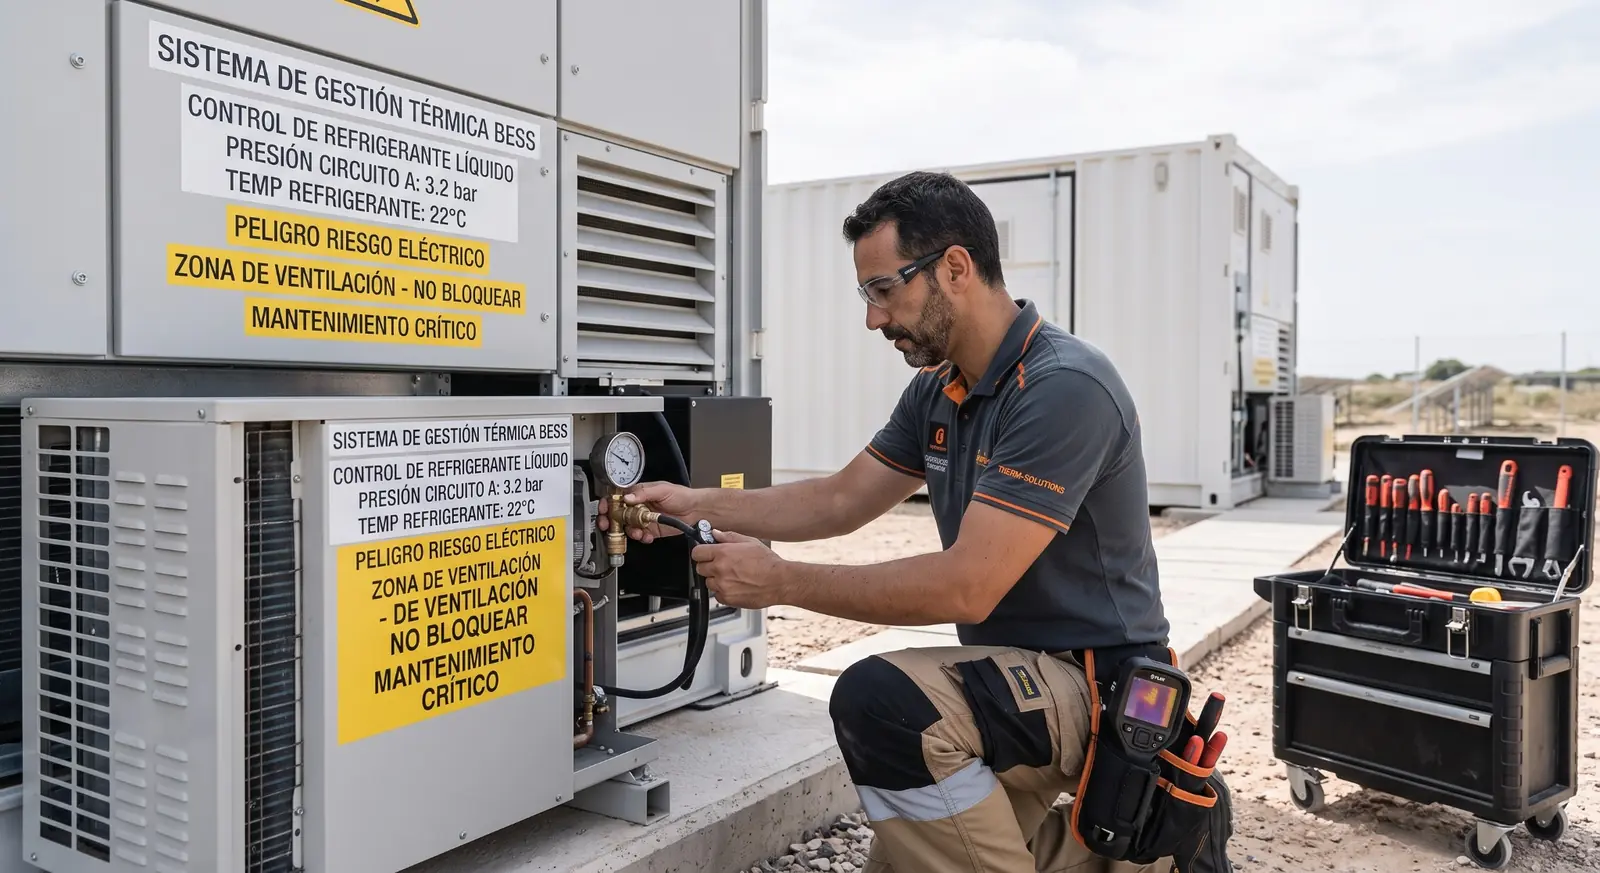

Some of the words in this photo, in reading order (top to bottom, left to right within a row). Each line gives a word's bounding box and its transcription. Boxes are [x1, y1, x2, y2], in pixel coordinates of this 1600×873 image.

[158, 34, 270, 86] SISTEMA
[278, 65, 307, 95] DE
[315, 75, 402, 119] GESTIÓN
[408, 98, 489, 140] TÉRMICA
[495, 121, 535, 151] BESS
[188, 94, 287, 135] CONTROL
[293, 116, 318, 142] DE
[325, 124, 451, 170] REFRIGERANTE
[456, 150, 514, 183] LÍQUIDO
[227, 135, 312, 172] PRESIÓN
[319, 154, 399, 188] CIRCUITO
[404, 171, 420, 192] A:
[425, 176, 449, 197] 3.2
[454, 181, 477, 202] bar
[227, 168, 282, 197] TEMP
[289, 180, 425, 222] REFRIGERANTE:
[430, 205, 466, 228] 22°C
[235, 214, 320, 247] PELIGRO
[327, 228, 392, 256] RIESGO
[399, 237, 484, 268] ELÉCTRICO
[175, 253, 235, 281] ZONA
[242, 260, 269, 284] DE
[274, 264, 395, 296] VENTILACIÓN
[414, 279, 437, 300] NO
[442, 282, 521, 308] BLOQUEAR
[252, 306, 409, 337] MANTENIMIENTO
[415, 315, 476, 341] CRÍTICO
[333, 430, 398, 450] SISTEMA
[403, 429, 421, 446] DE
[425, 423, 480, 445] GESTIÓN
[483, 422, 536, 442] TÉRMICA
[539, 423, 568, 439] BESS
[333, 464, 402, 485] CONTROL
[406, 462, 424, 479] DE
[428, 455, 521, 478] REFRIGERANTE
[524, 451, 568, 470] LÍQUIDO
[359, 484, 420, 509] PRESIÓN
[425, 481, 484, 501] CIRCUITO
[488, 480, 500, 496] A:
[503, 478, 522, 495] 3.2
[525, 477, 544, 493] bar
[998, 464, 1066, 495] THERM-SOLUTIONS
[358, 514, 399, 535] TEMP
[403, 503, 503, 530] REFRIGERANTE:
[507, 499, 535, 517] 22°C
[356, 543, 424, 570] PELIGRO
[429, 535, 481, 559] RIESGO
[486, 524, 555, 551] ELÉCTRICO
[372, 574, 419, 600] ZONA
[423, 569, 443, 591] DE
[448, 551, 540, 585] VENTILACIÓN
[394, 599, 419, 625] DE
[424, 574, 538, 618] VENTILACIÓN
[391, 628, 420, 656] NO
[427, 605, 528, 647] BLOQUEAR
[375, 633, 535, 694] MANTENIMIENTO
[422, 670, 499, 711] CRÍTICO
